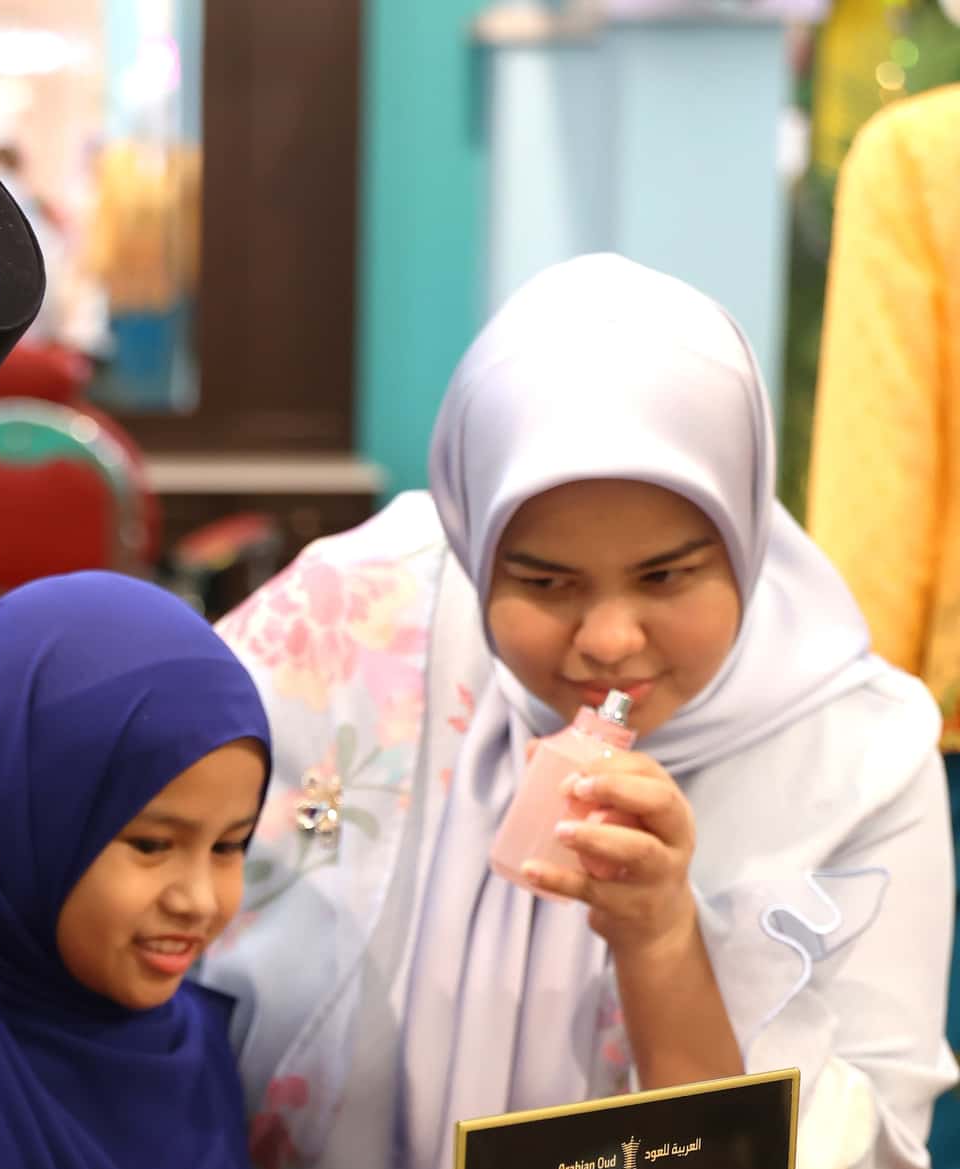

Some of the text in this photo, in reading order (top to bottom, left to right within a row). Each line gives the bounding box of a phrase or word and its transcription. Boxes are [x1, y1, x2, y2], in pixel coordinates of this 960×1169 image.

[643, 1137, 702, 1162] العربية للعود
[597, 1154, 617, 1169] Oud
